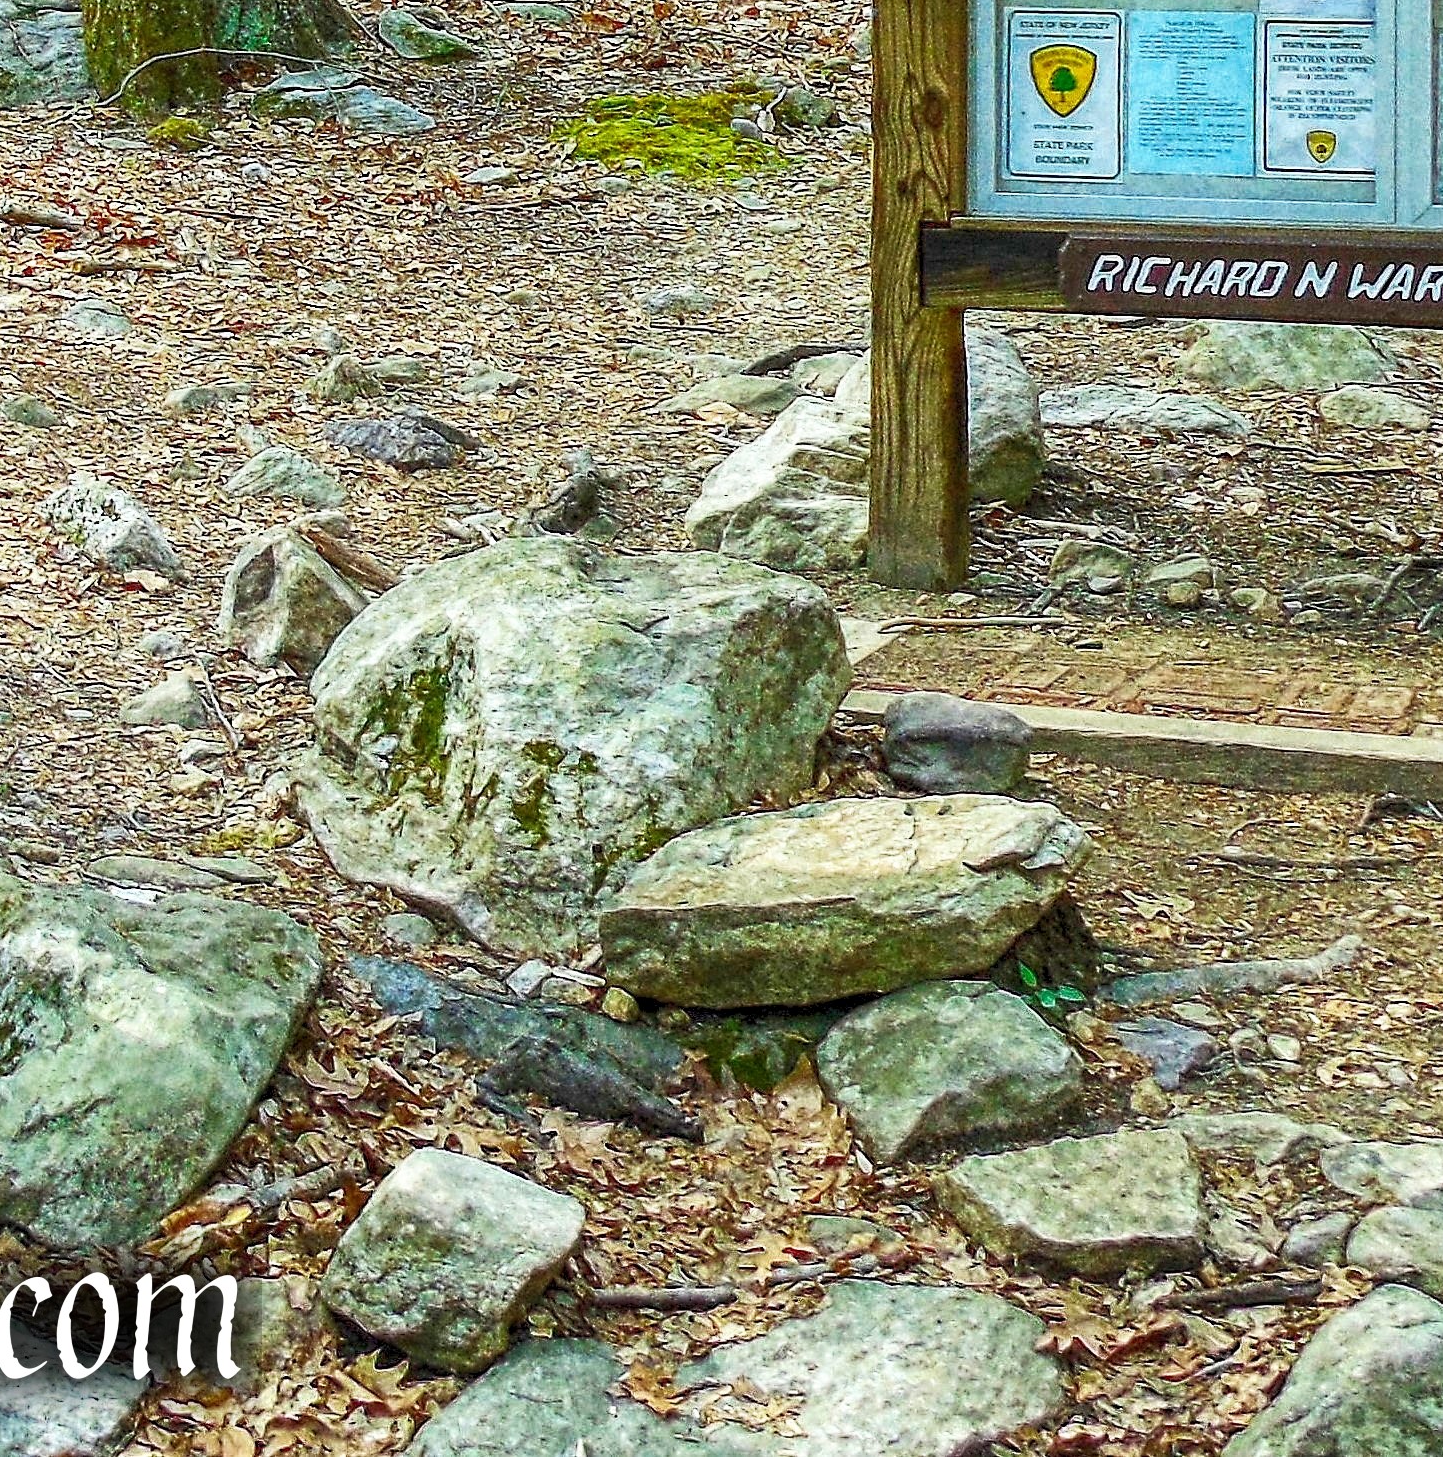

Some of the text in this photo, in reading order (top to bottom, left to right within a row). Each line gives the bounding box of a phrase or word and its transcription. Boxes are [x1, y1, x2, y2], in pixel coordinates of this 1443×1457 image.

[1033, 140, 1094, 151] STATE PARK
[1034, 154, 1091, 165] BOUNDARY
[1086, 253, 1289, 299] RICHARD
[1293, 259, 1339, 299] N
